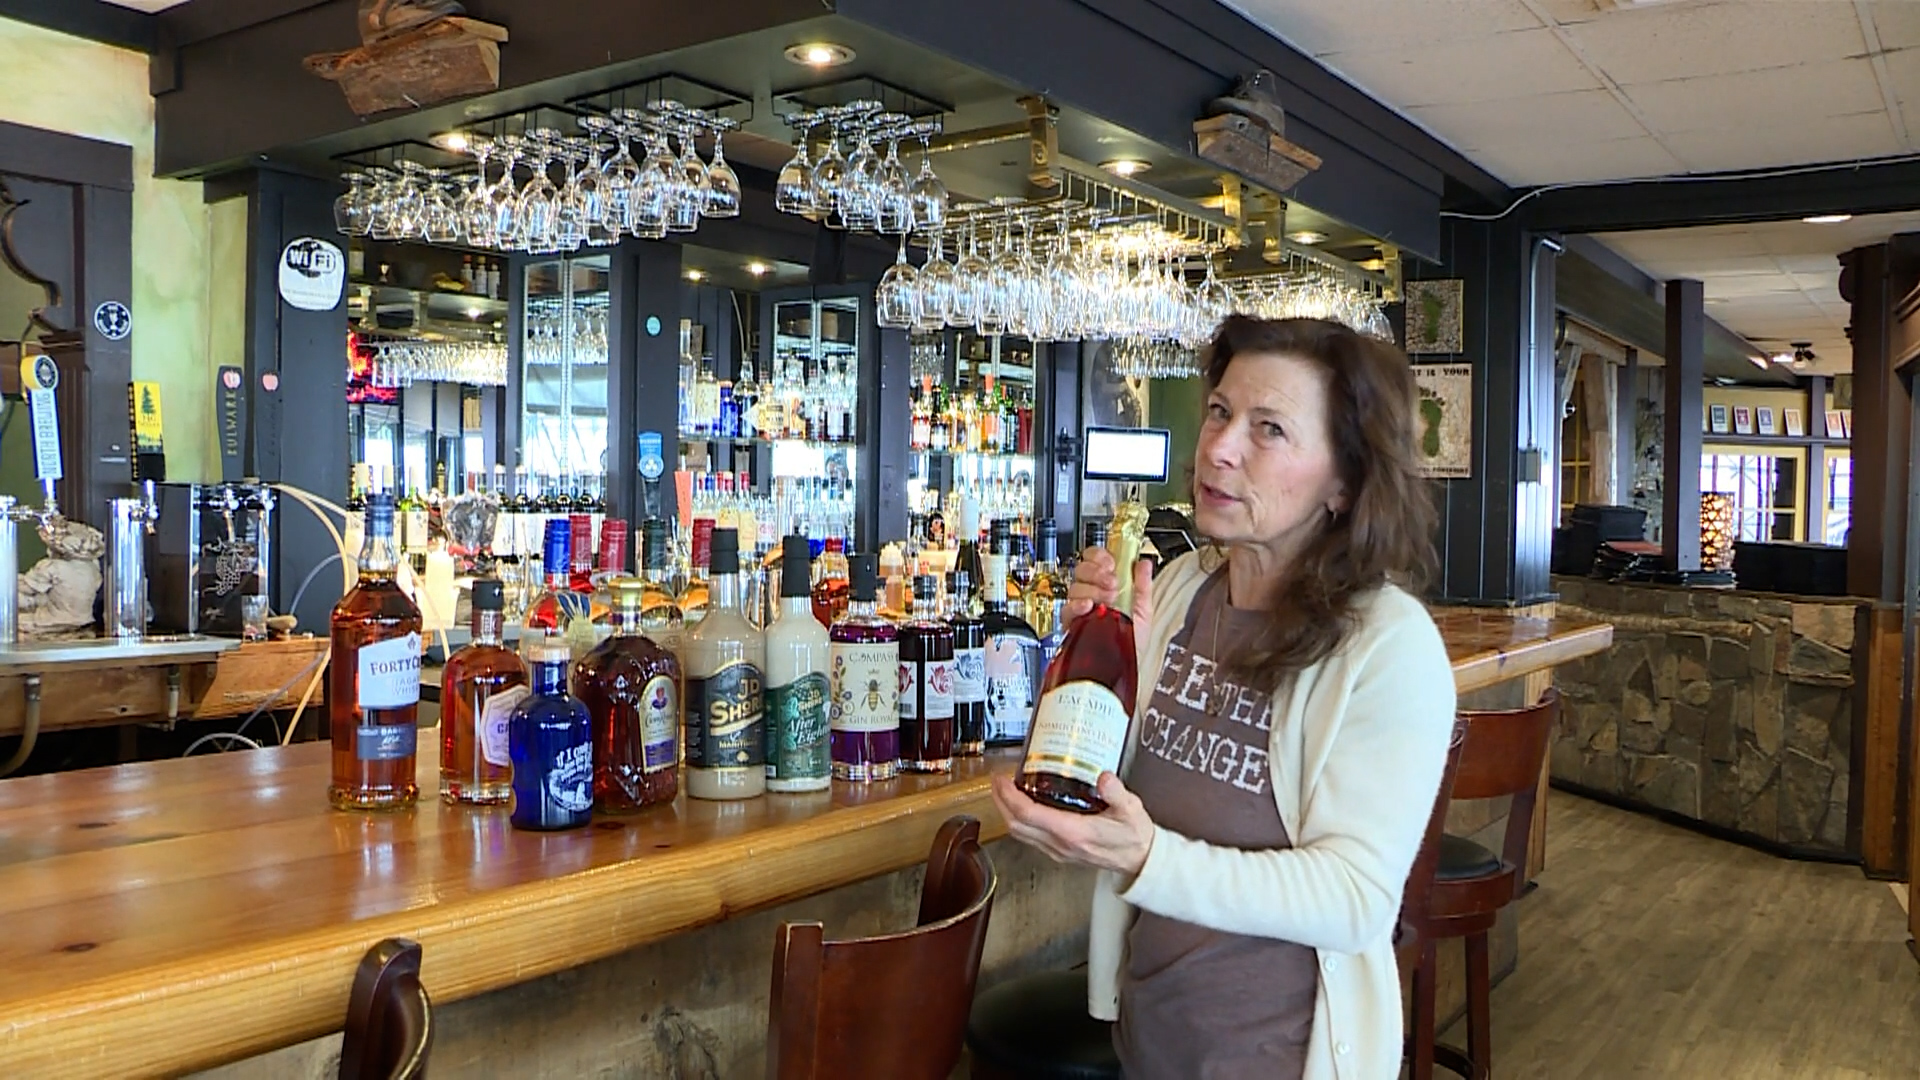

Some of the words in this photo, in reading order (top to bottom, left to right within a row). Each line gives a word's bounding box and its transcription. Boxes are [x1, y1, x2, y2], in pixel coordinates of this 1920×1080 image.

[1443, 367, 1469, 376] YOUR
[225, 389, 238, 456] BULWARK
[737, 679, 760, 700] JD
[1141, 707, 1270, 794] CHANGE
